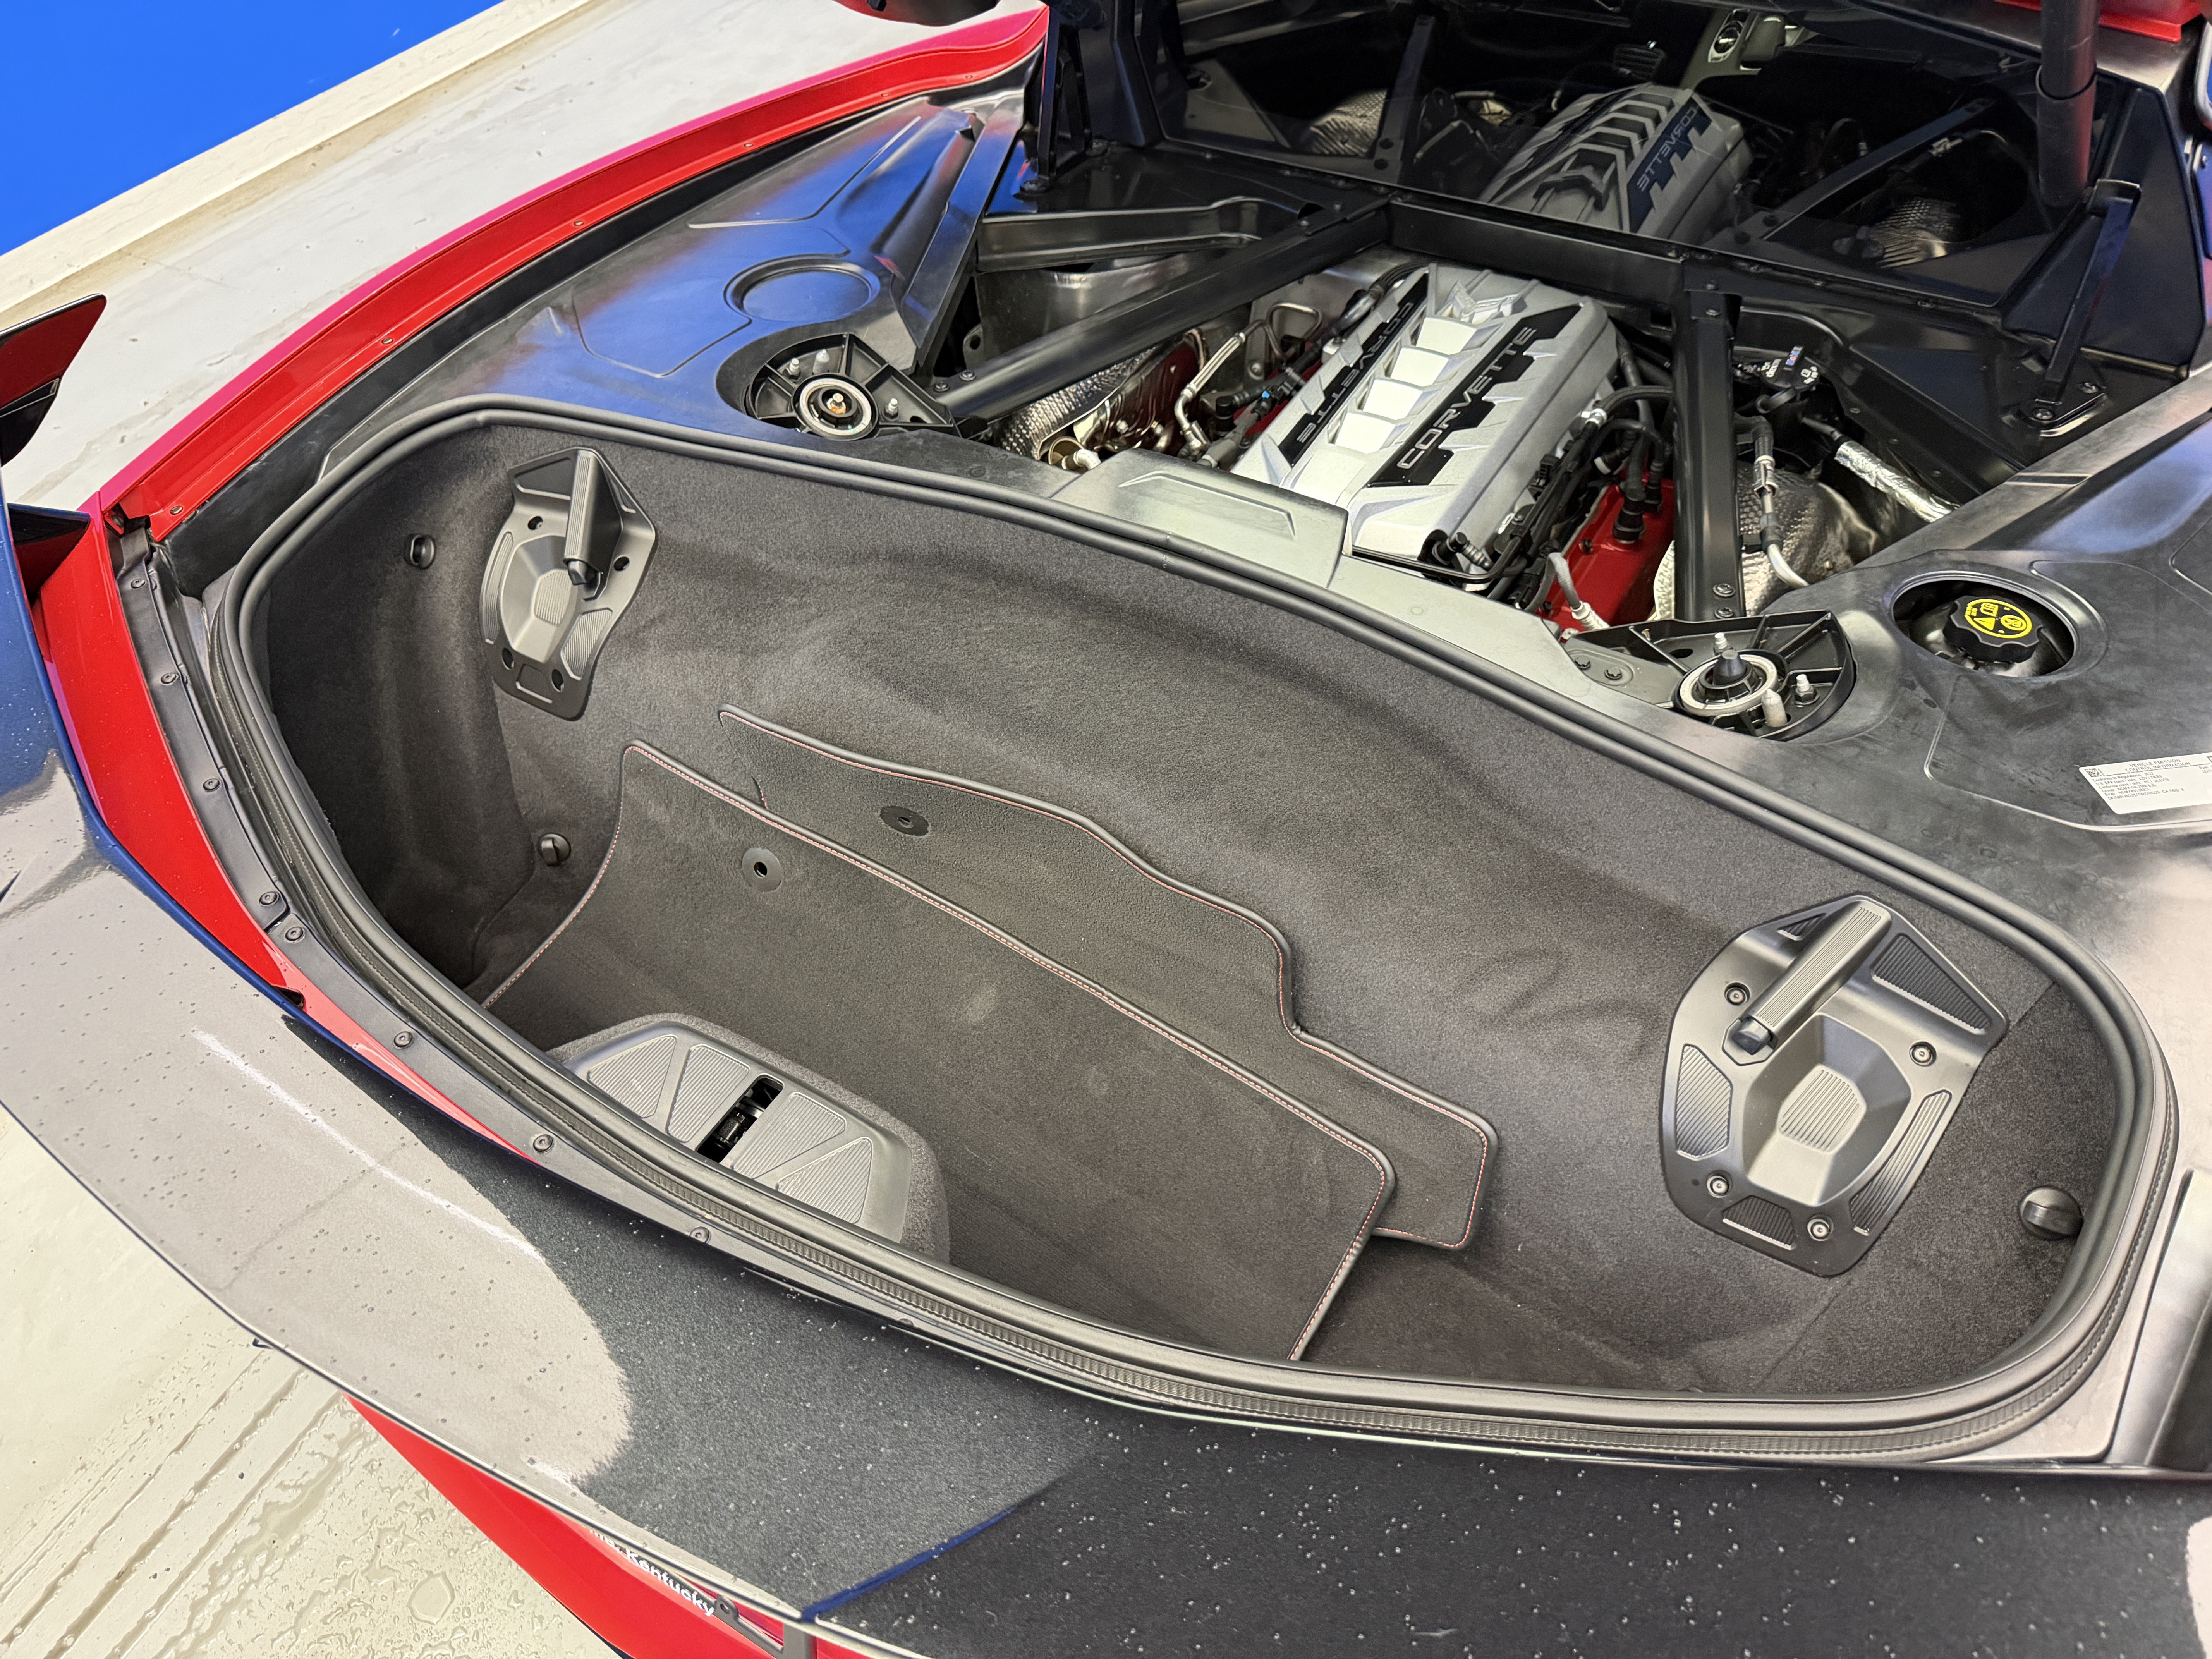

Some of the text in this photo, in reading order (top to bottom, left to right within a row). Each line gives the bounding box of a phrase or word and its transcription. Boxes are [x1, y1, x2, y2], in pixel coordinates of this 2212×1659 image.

[1296, 302, 1414, 443] CORVETTE
[1397, 327, 1537, 469] CORVETTE
[626, 1549, 715, 1616] Kentucky
